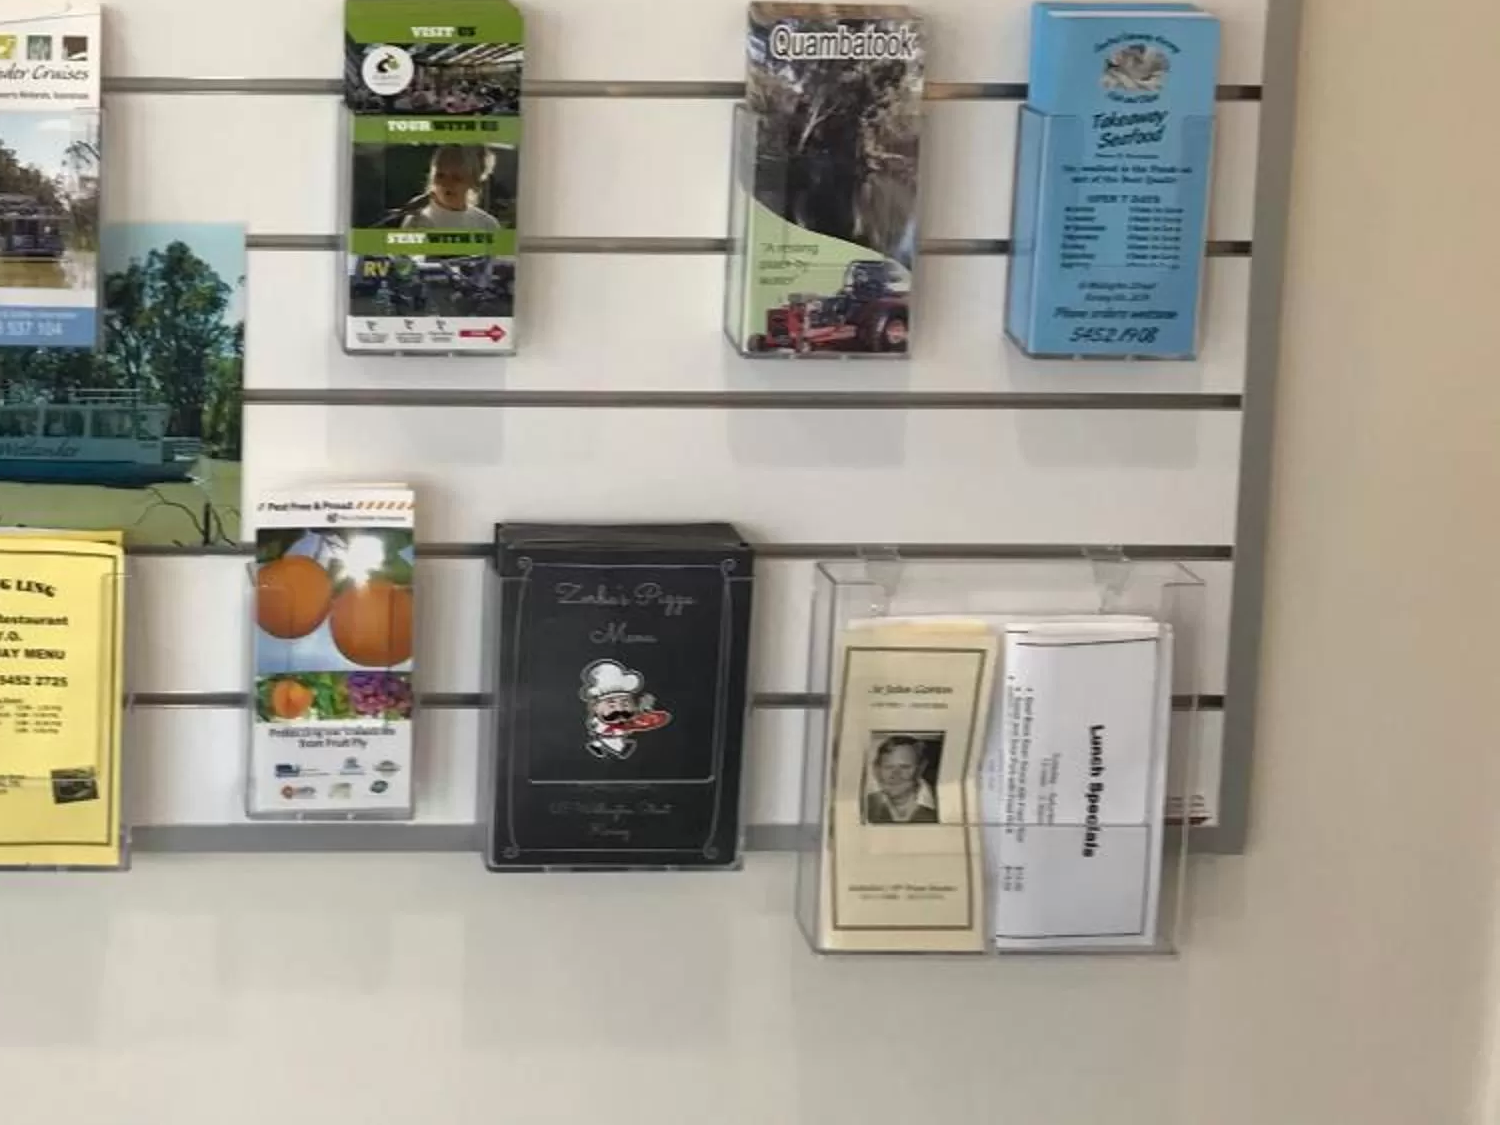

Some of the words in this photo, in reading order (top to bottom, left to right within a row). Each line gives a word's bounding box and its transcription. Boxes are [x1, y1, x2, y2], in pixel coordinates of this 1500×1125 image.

[411, 26, 456, 38] VISIT
[770, 24, 917, 61] Quambatook
[32, 64, 90, 81] Cruises
[388, 120, 431, 132] TOUR
[363, 260, 391, 277] RV
[24, 649, 66, 660] MENU
[0, 675, 31, 687] 5452
[1086, 724, 1106, 778] Lunch
[1081, 781, 1105, 858] Specials
